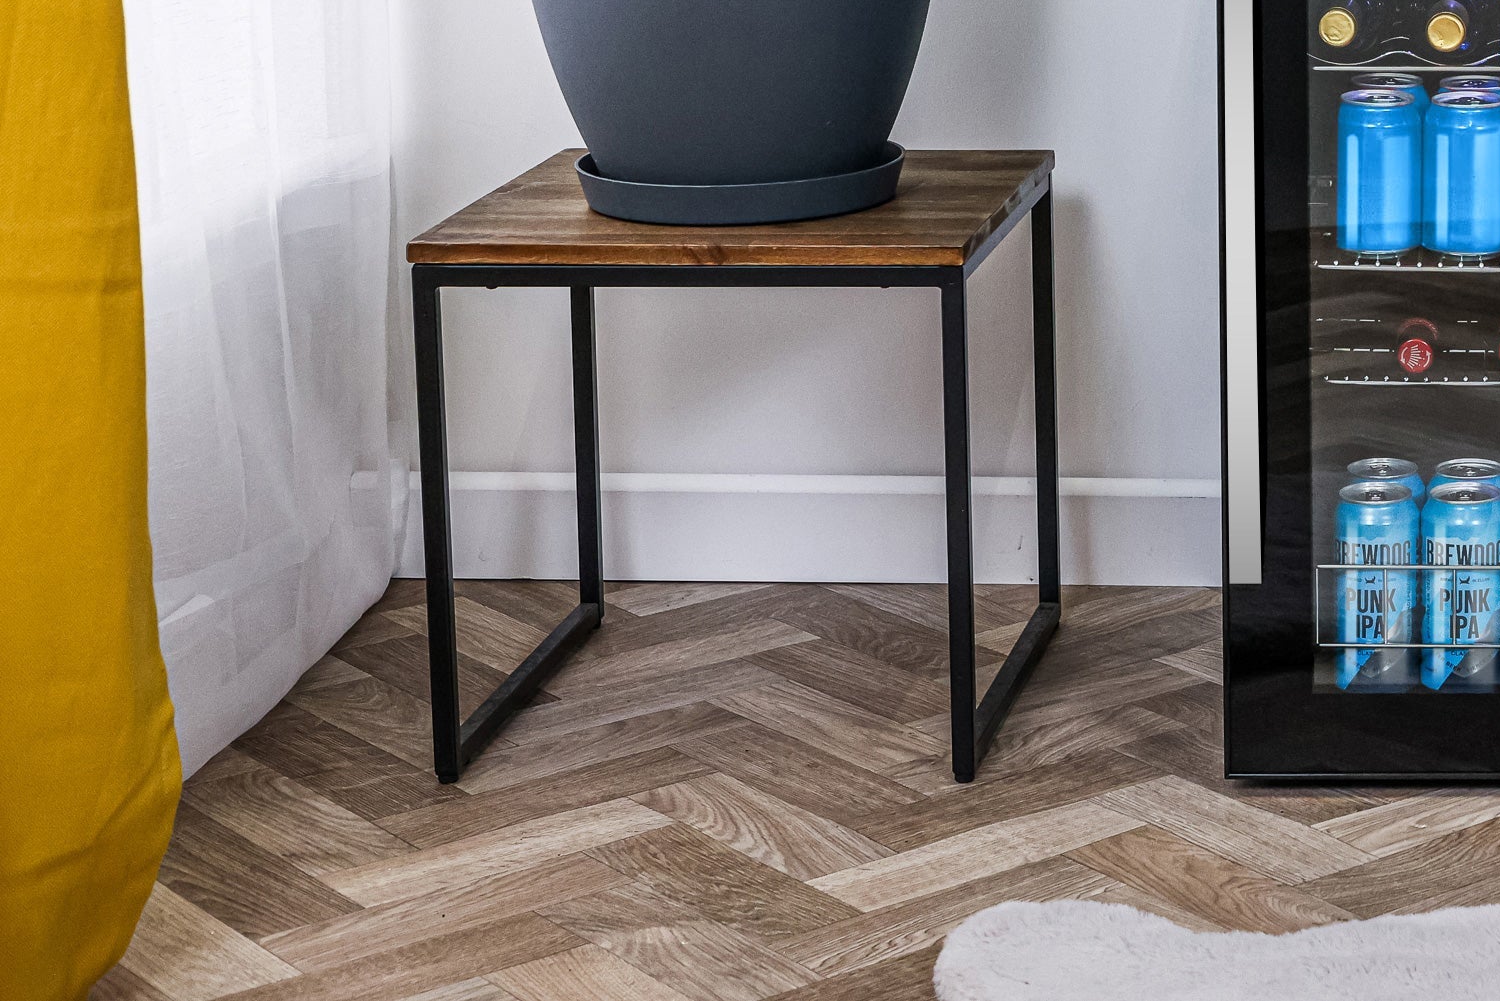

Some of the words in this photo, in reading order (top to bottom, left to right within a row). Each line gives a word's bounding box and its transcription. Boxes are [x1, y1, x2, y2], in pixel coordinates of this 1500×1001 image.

[1345, 587, 1396, 614] PUNK
[1439, 587, 1490, 614] PUNK
[1355, 614, 1385, 639] IPA
[1449, 615, 1480, 639] IPA
